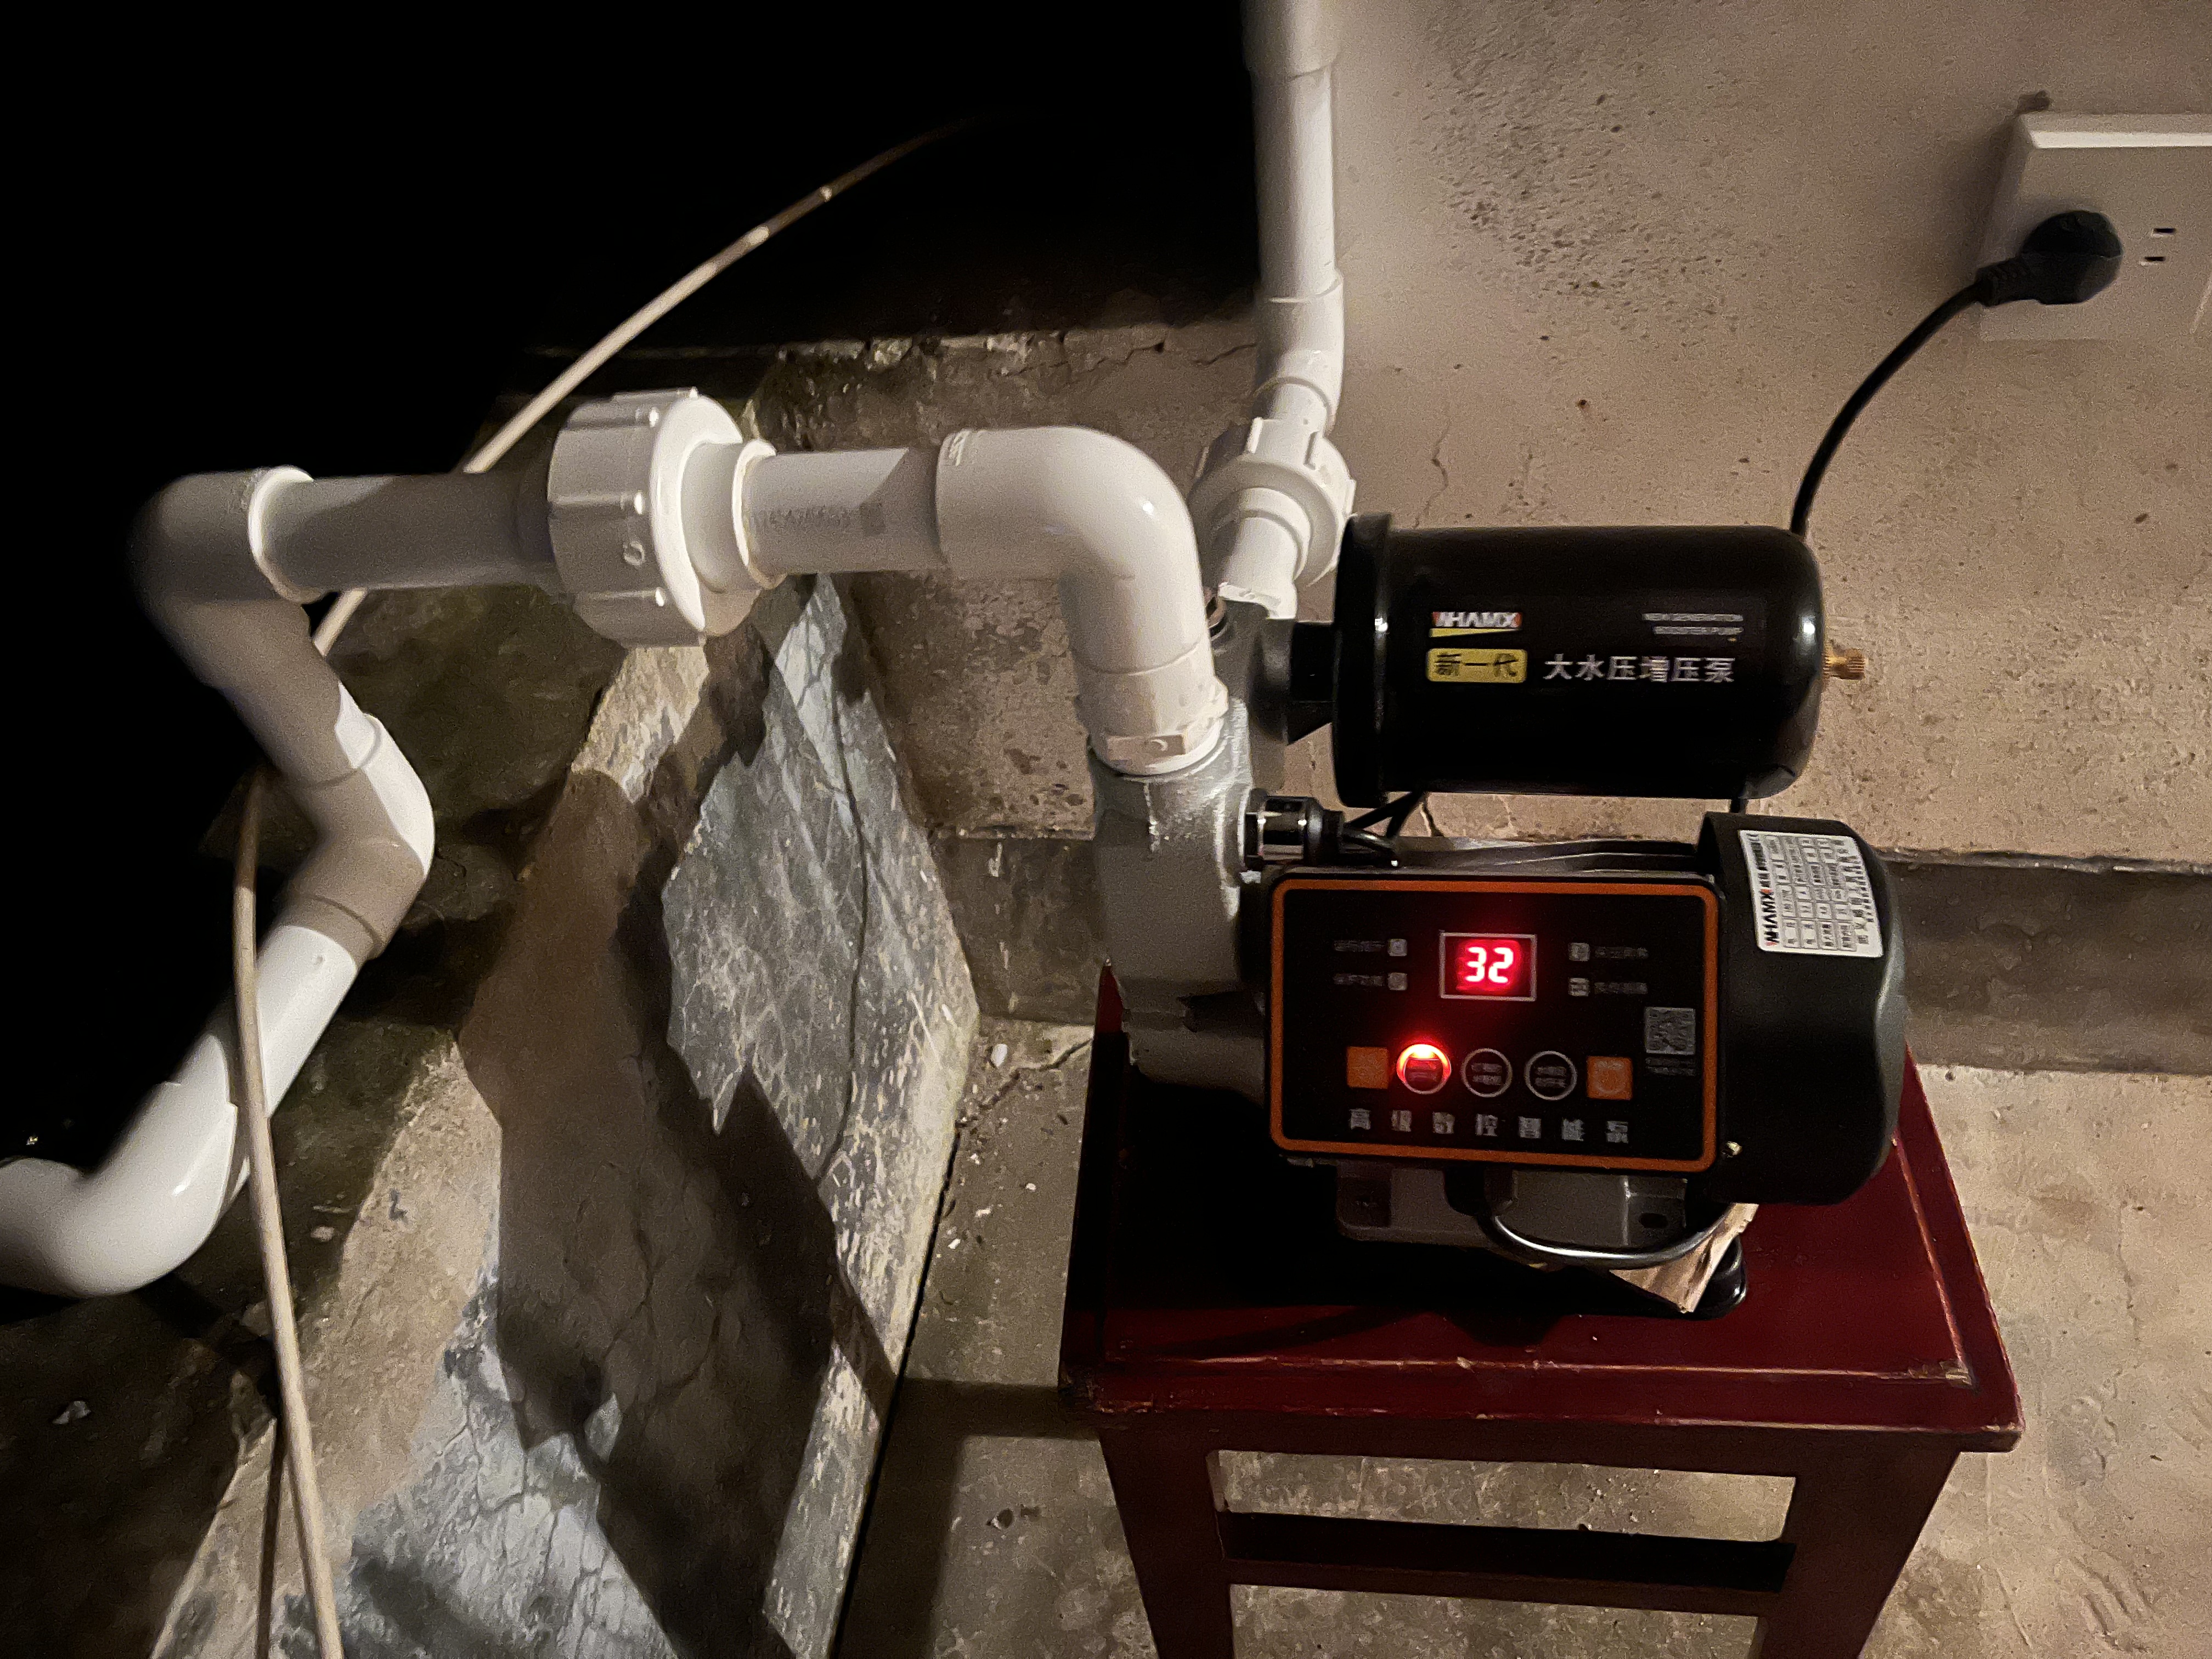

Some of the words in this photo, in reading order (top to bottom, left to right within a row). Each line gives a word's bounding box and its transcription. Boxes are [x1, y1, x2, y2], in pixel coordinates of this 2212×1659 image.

[1434, 651, 1519, 677] 新一代
[1543, 653, 1736, 683] 大水压增压泵
[1465, 946, 1514, 983] 32
